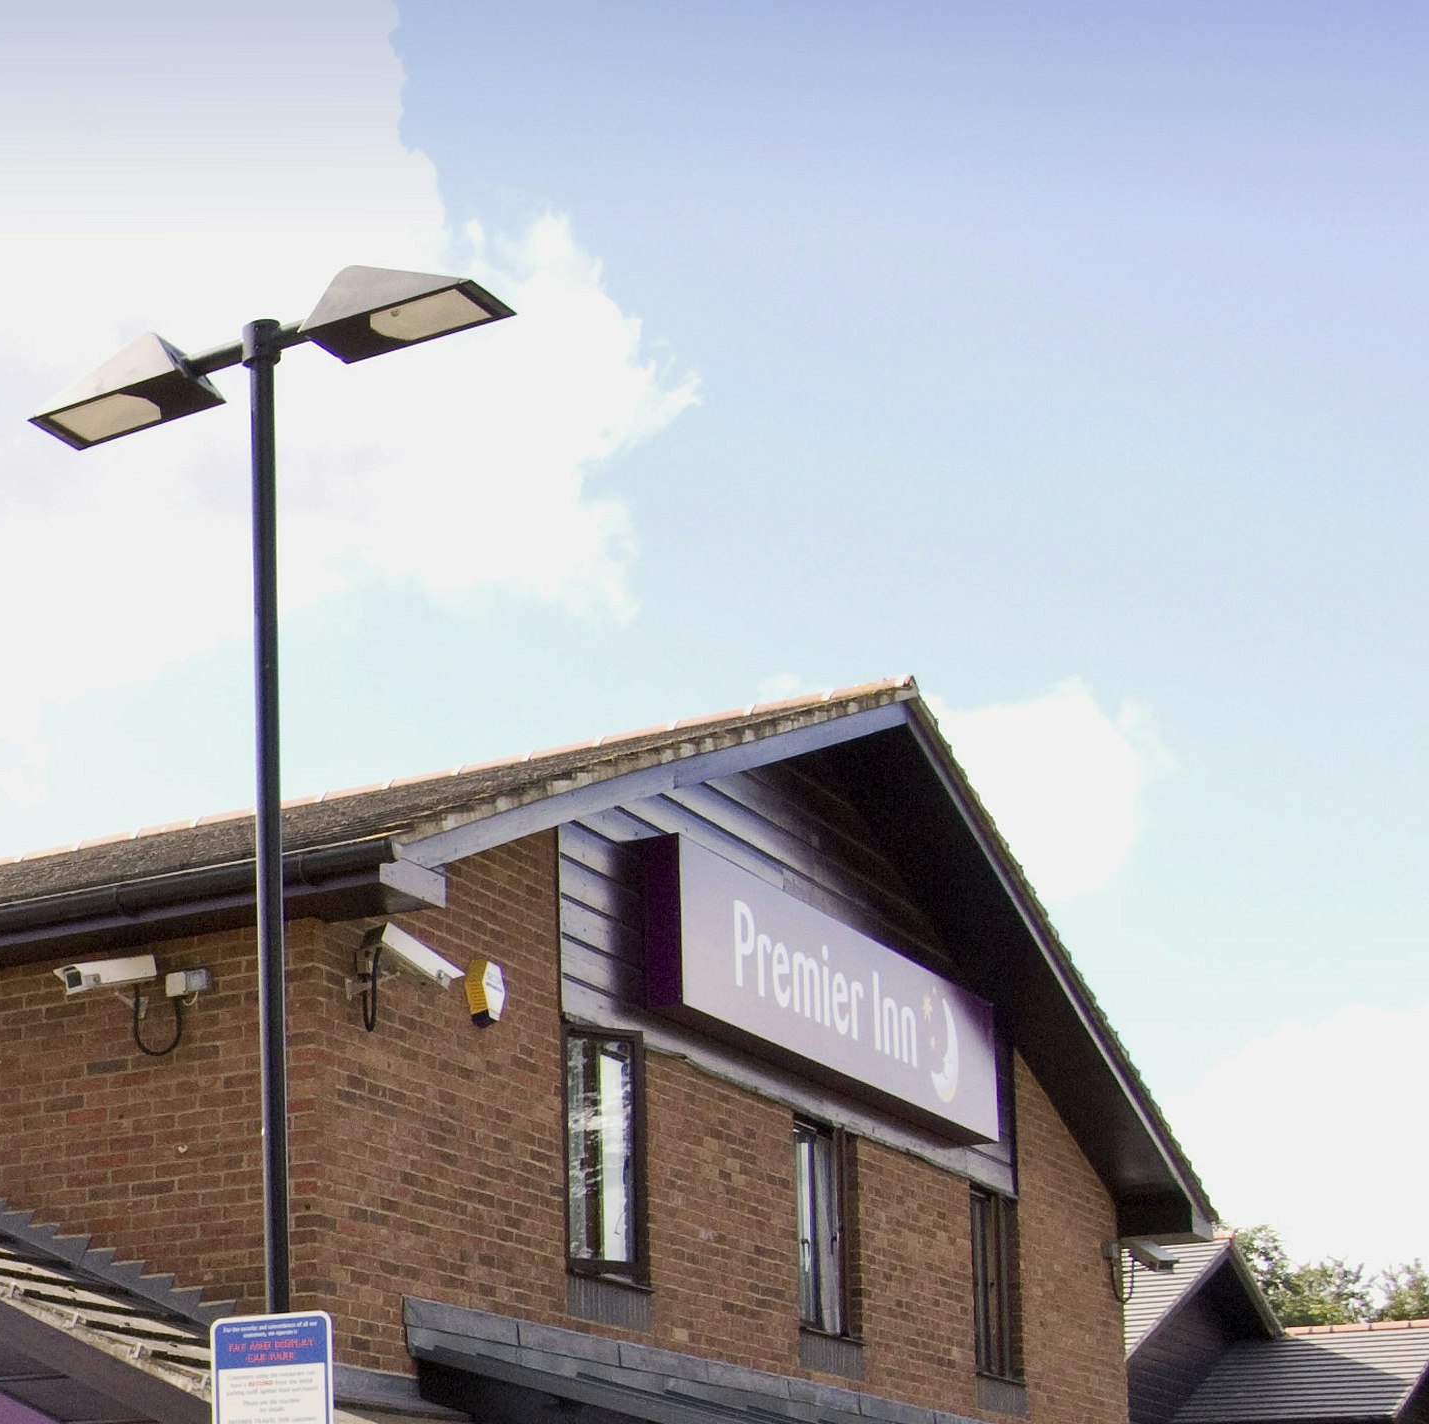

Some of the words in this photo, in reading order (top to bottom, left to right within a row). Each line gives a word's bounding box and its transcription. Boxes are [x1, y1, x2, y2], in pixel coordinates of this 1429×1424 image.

[733, 899, 864, 1041] Premier
[872, 970, 918, 1068] Inn
[228, 1343, 246, 1352] PAY
[250, 1341, 271, 1350] AND
[246, 1353, 266, 1363] CAR
[270, 1352, 294, 1361] PARK
